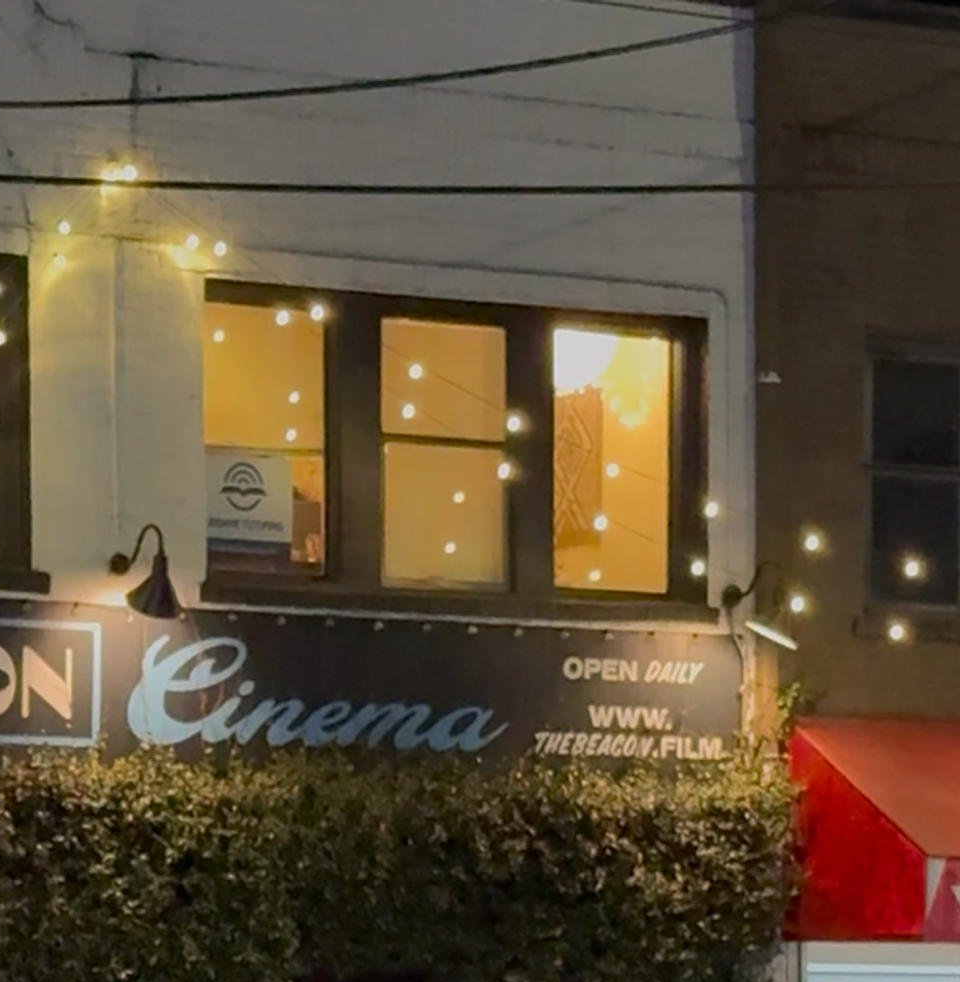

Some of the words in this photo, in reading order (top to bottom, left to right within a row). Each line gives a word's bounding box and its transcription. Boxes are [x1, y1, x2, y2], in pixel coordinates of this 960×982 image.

[127, 634, 508, 752] Cinema
[563, 656, 638, 682] OPEN
[643, 660, 704, 684] DAILY
